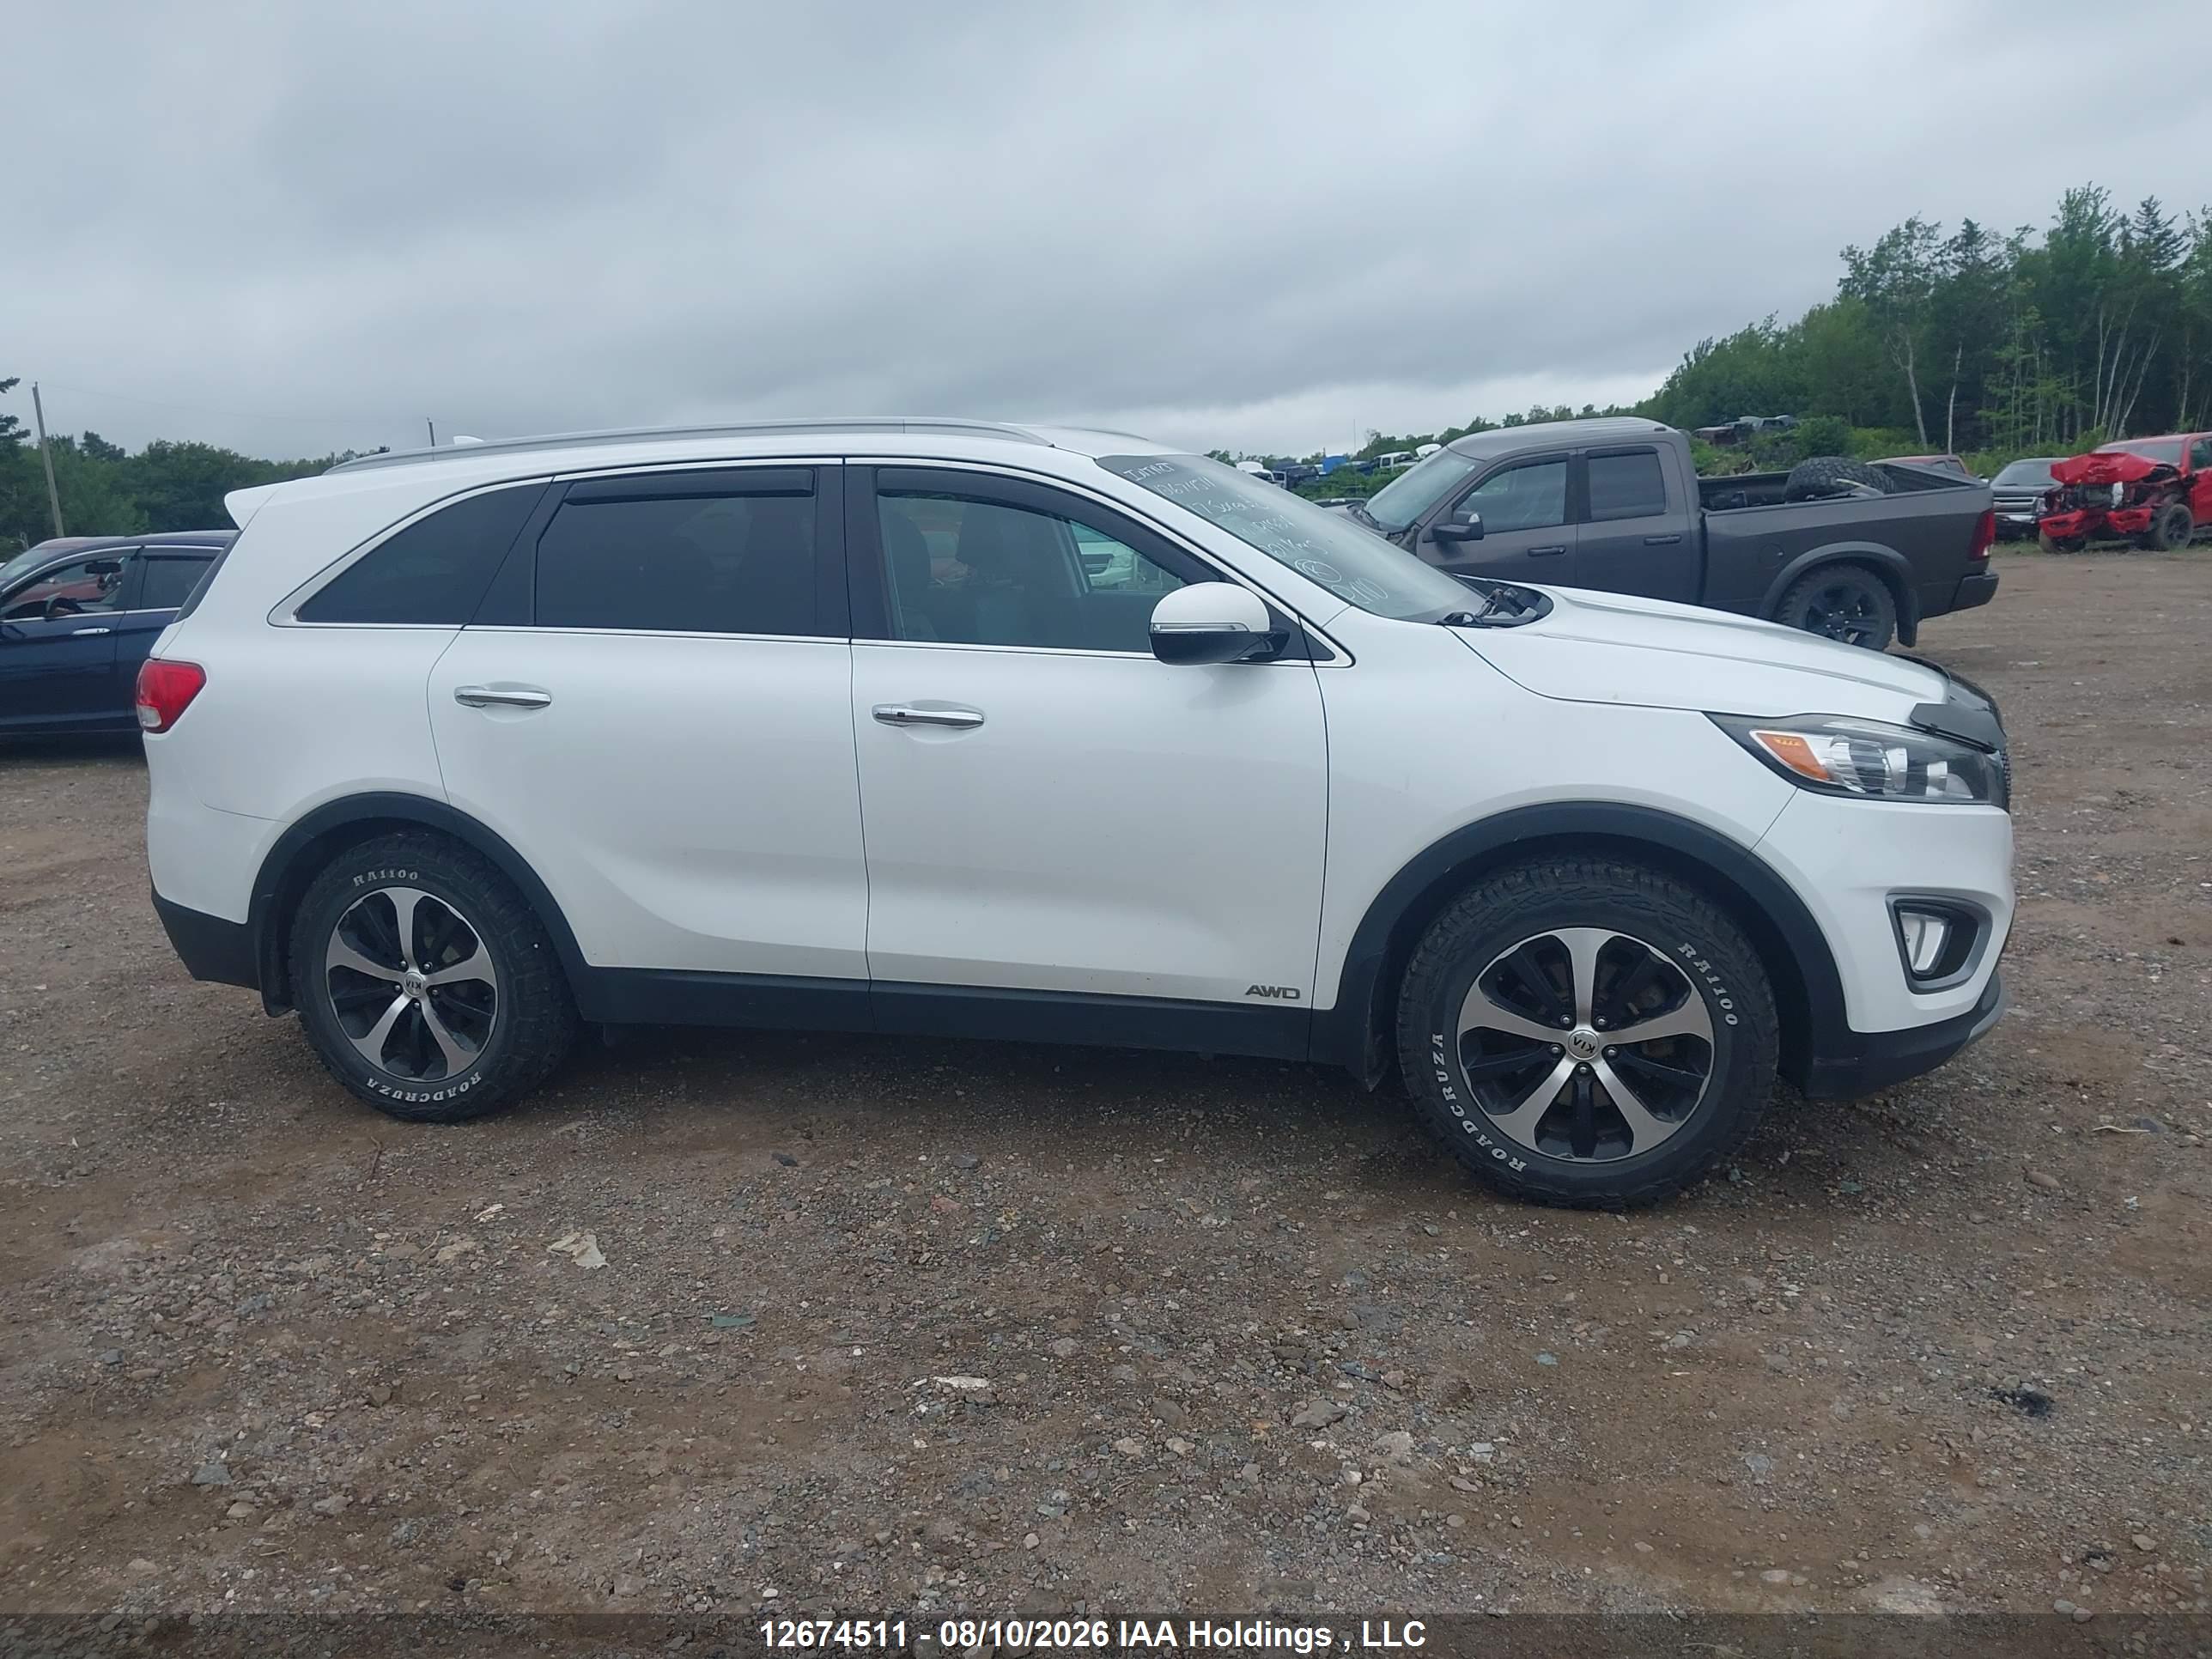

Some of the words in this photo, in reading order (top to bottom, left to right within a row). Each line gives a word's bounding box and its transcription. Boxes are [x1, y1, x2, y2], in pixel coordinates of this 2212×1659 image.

[352, 869, 419, 887] RA1100
[1245, 984, 1301, 1000] AWD
[1677, 943, 1739, 1026] RA1100
[1572, 1036, 1596, 1054] KIA
[365, 1072, 483, 1103] ROADCRUZA
[1431, 1032, 1528, 1173] ROADCRUZA
